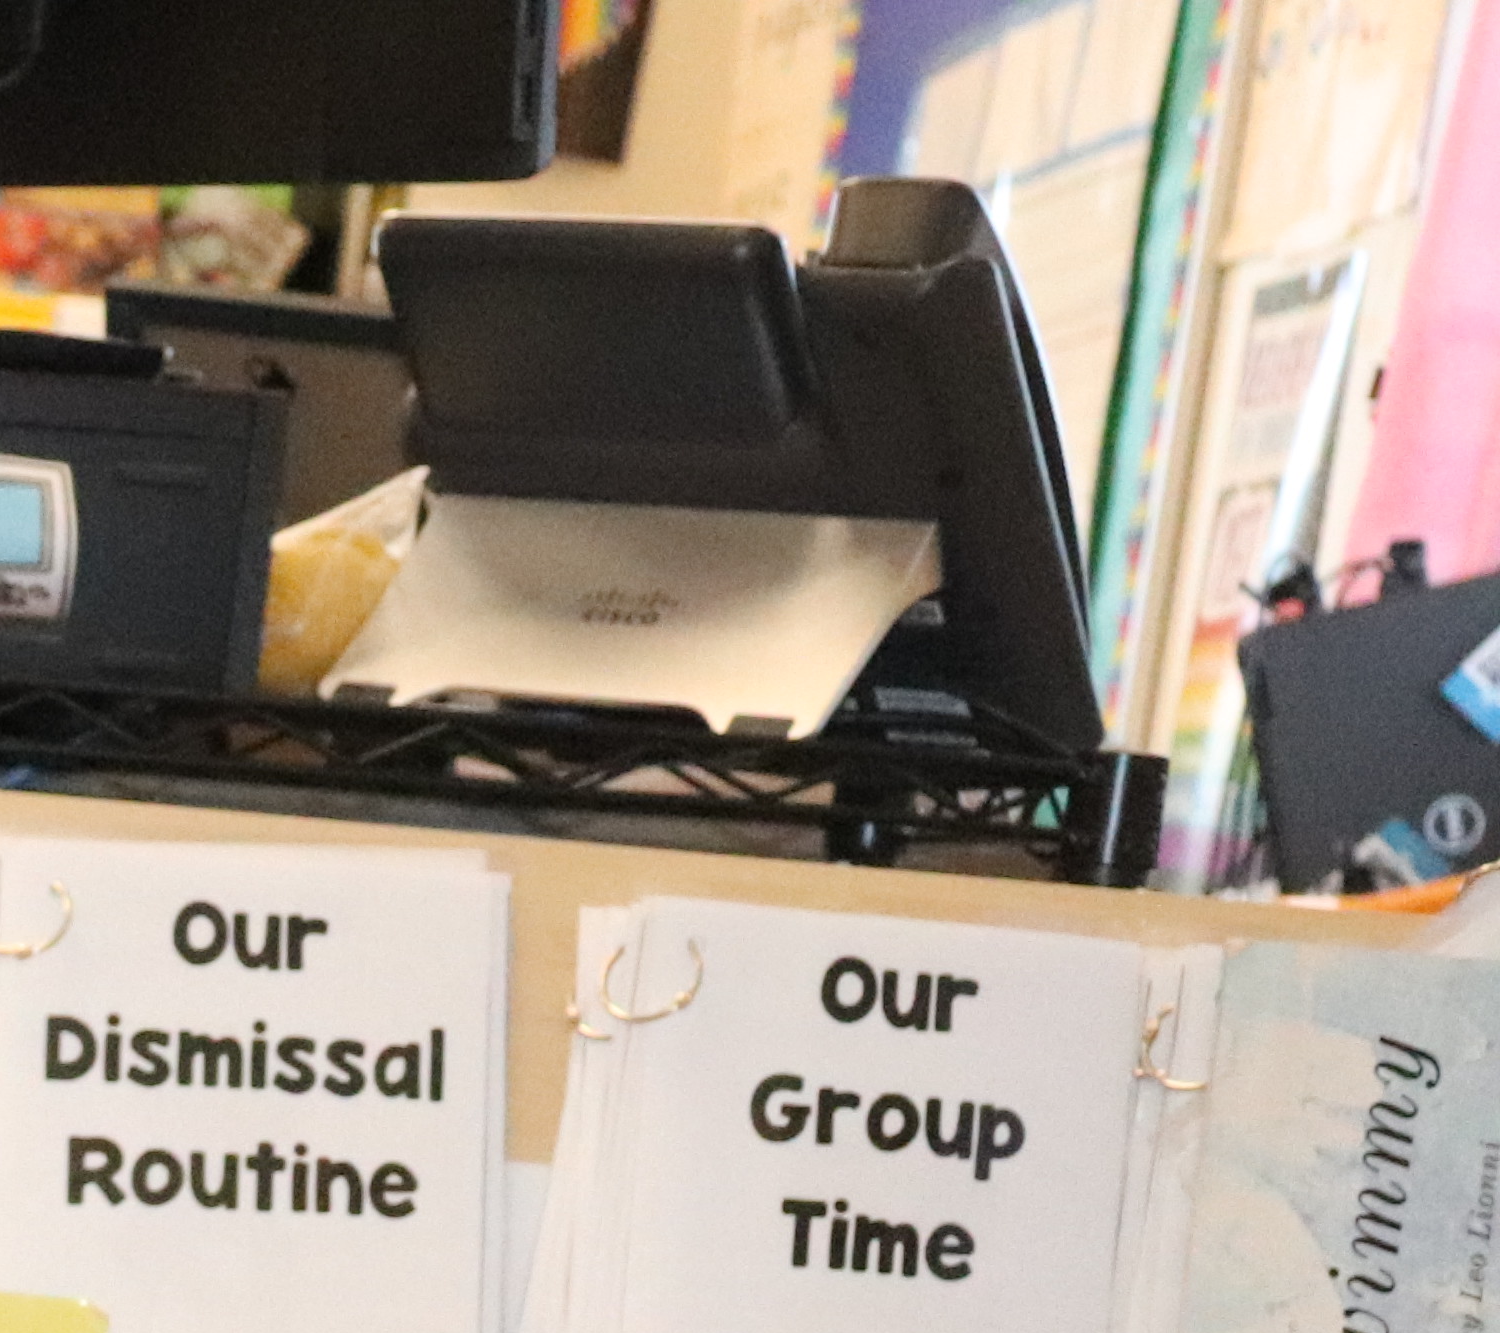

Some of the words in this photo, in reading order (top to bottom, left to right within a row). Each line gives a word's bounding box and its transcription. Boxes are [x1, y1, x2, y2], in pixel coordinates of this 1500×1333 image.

[173, 900, 329, 970] Our
[820, 956, 978, 1034] Our
[46, 1014, 444, 1101] Dismissal
[750, 1073, 1025, 1182] Group
[67, 1136, 418, 1217] Routine
[781, 1199, 975, 1281] Time
[1459, 1253, 1487, 1302] Leo
